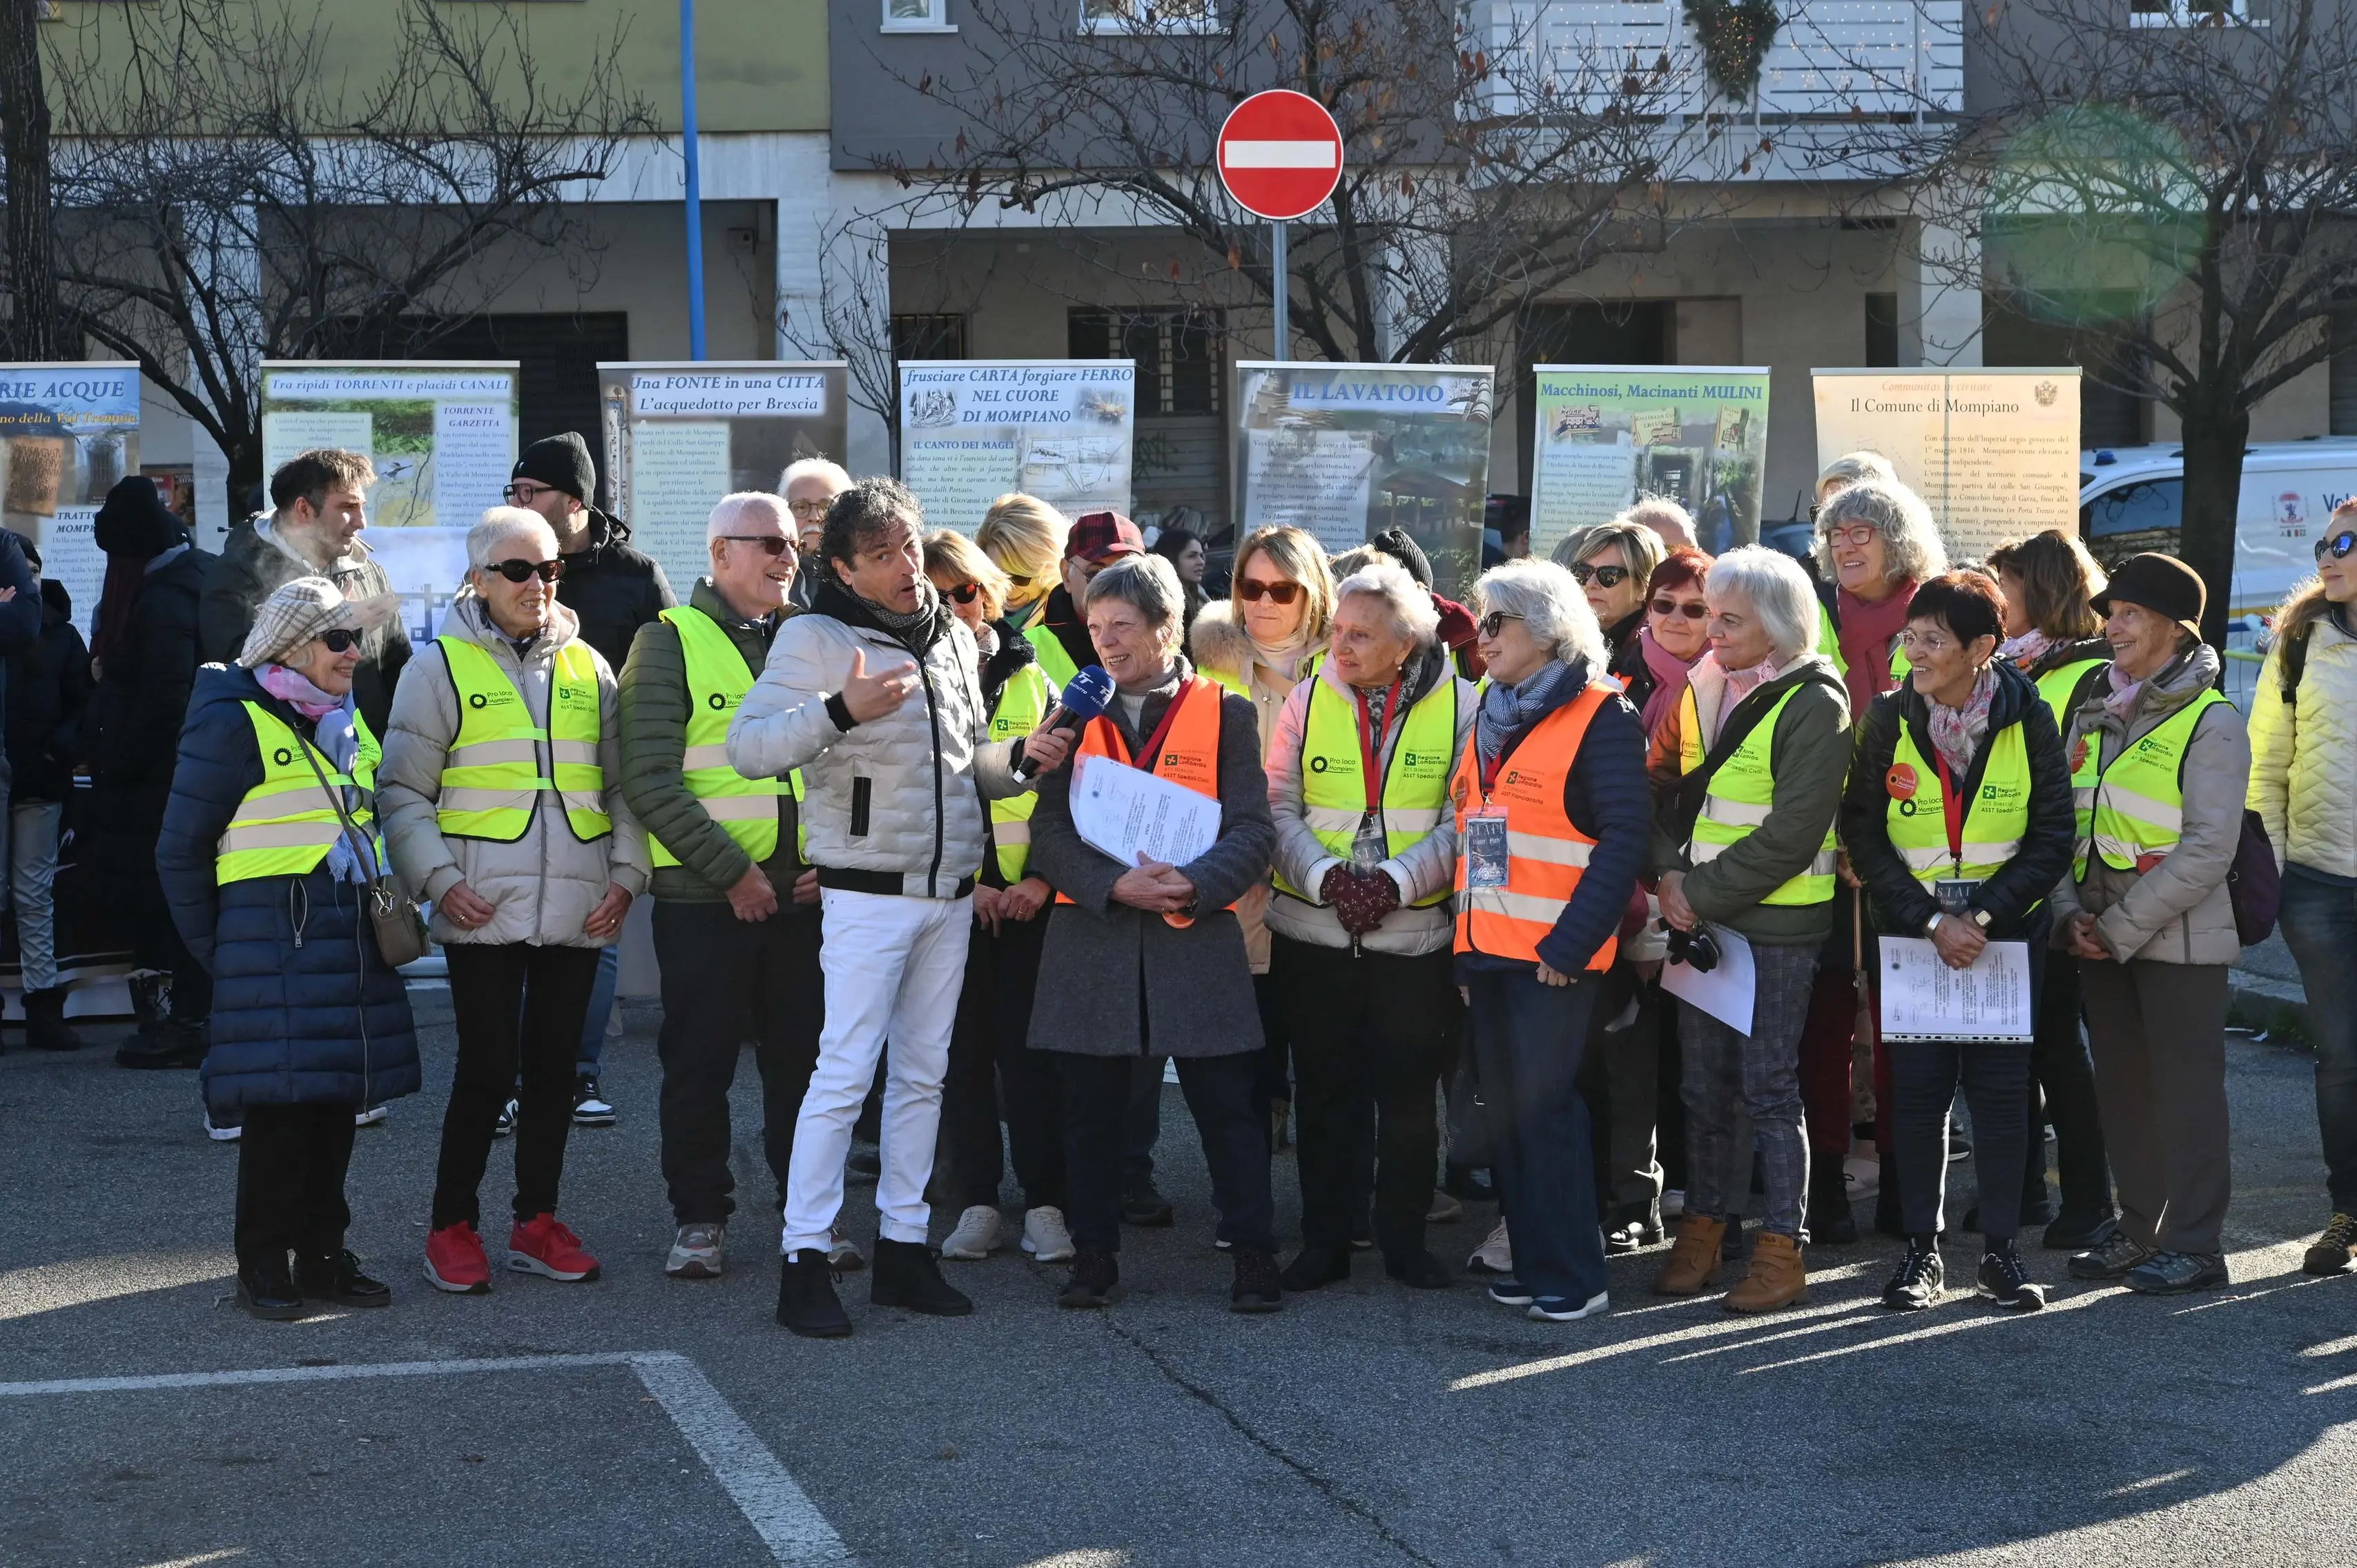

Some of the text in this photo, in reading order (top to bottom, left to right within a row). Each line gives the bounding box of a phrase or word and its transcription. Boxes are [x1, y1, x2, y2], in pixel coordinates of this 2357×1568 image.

[630, 376, 659, 389] Una
[665, 376, 721, 389] FONTE
[725, 377, 739, 388] in
[744, 379, 771, 388] una
[904, 369, 1133, 386] frusciare CARTA forgiare FERRO
[272, 380, 293, 389] Tra
[297, 379, 329, 392] ripidi
[334, 380, 403, 389] TORRENTI
[416, 380, 455, 392] placidi
[460, 380, 508, 389] CANALI
[1882, 380, 1992, 391] Communitas in civitate
[43, 381, 124, 402] ACQUE
[972, 390, 1059, 402] NEL CUORE
[1293, 383, 1444, 402] IL LAVATOIO
[1540, 384, 1762, 399] Macchinosi, Macinanti MULINI
[640, 398, 817, 414] L'acquedotto per Brescia
[1851, 399, 2019, 417] Il Comune di Mompiano
[19, 412, 50, 423] della
[57, 412, 77, 423] Val
[962, 411, 1071, 422] DI MOMPIANO
[1968, 435, 2007, 444] dell'Imperial
[1983, 447, 2015, 456] Mompiano
[1962, 483, 1983, 492] partiva
[2035, 484, 2068, 493] Giuseppe,
[1992, 494, 2009, 503] lungo
[1983, 518, 2068, 527] giungendo comprendere
[2140, 757, 2159, 766] Spedali
[1516, 780, 1542, 788] Lombardia
[1511, 793, 1543, 804] Franciacorta
